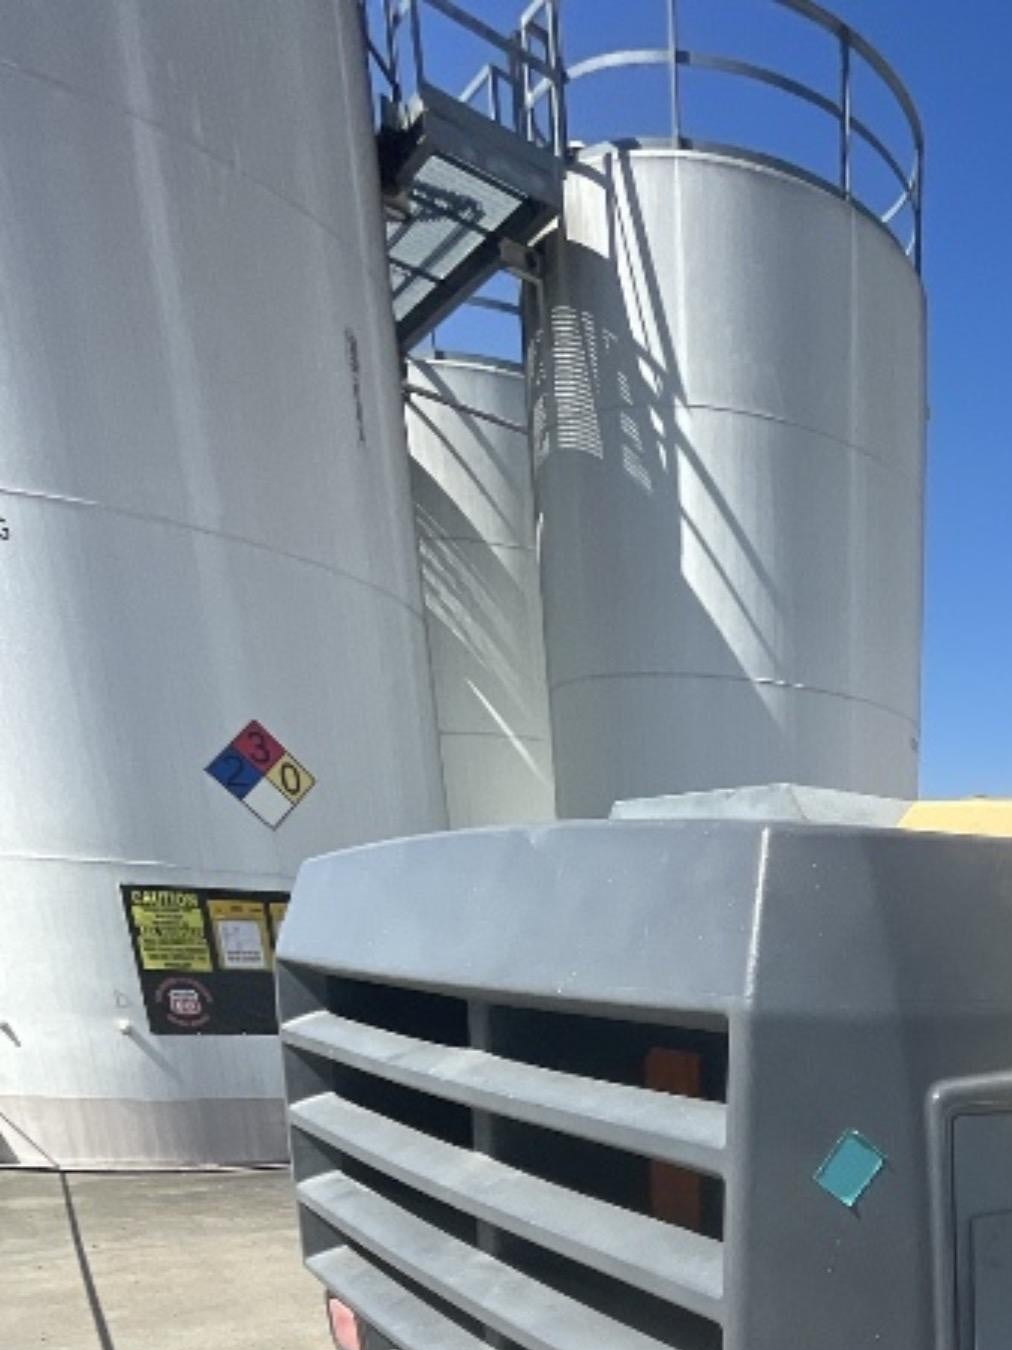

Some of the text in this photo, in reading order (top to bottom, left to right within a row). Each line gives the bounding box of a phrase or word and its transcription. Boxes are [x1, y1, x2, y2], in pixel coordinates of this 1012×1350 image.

[247, 731, 270, 764] 3
[224, 756, 252, 787] 2
[281, 762, 300, 796] 0
[131, 890, 199, 907] CAUTION
